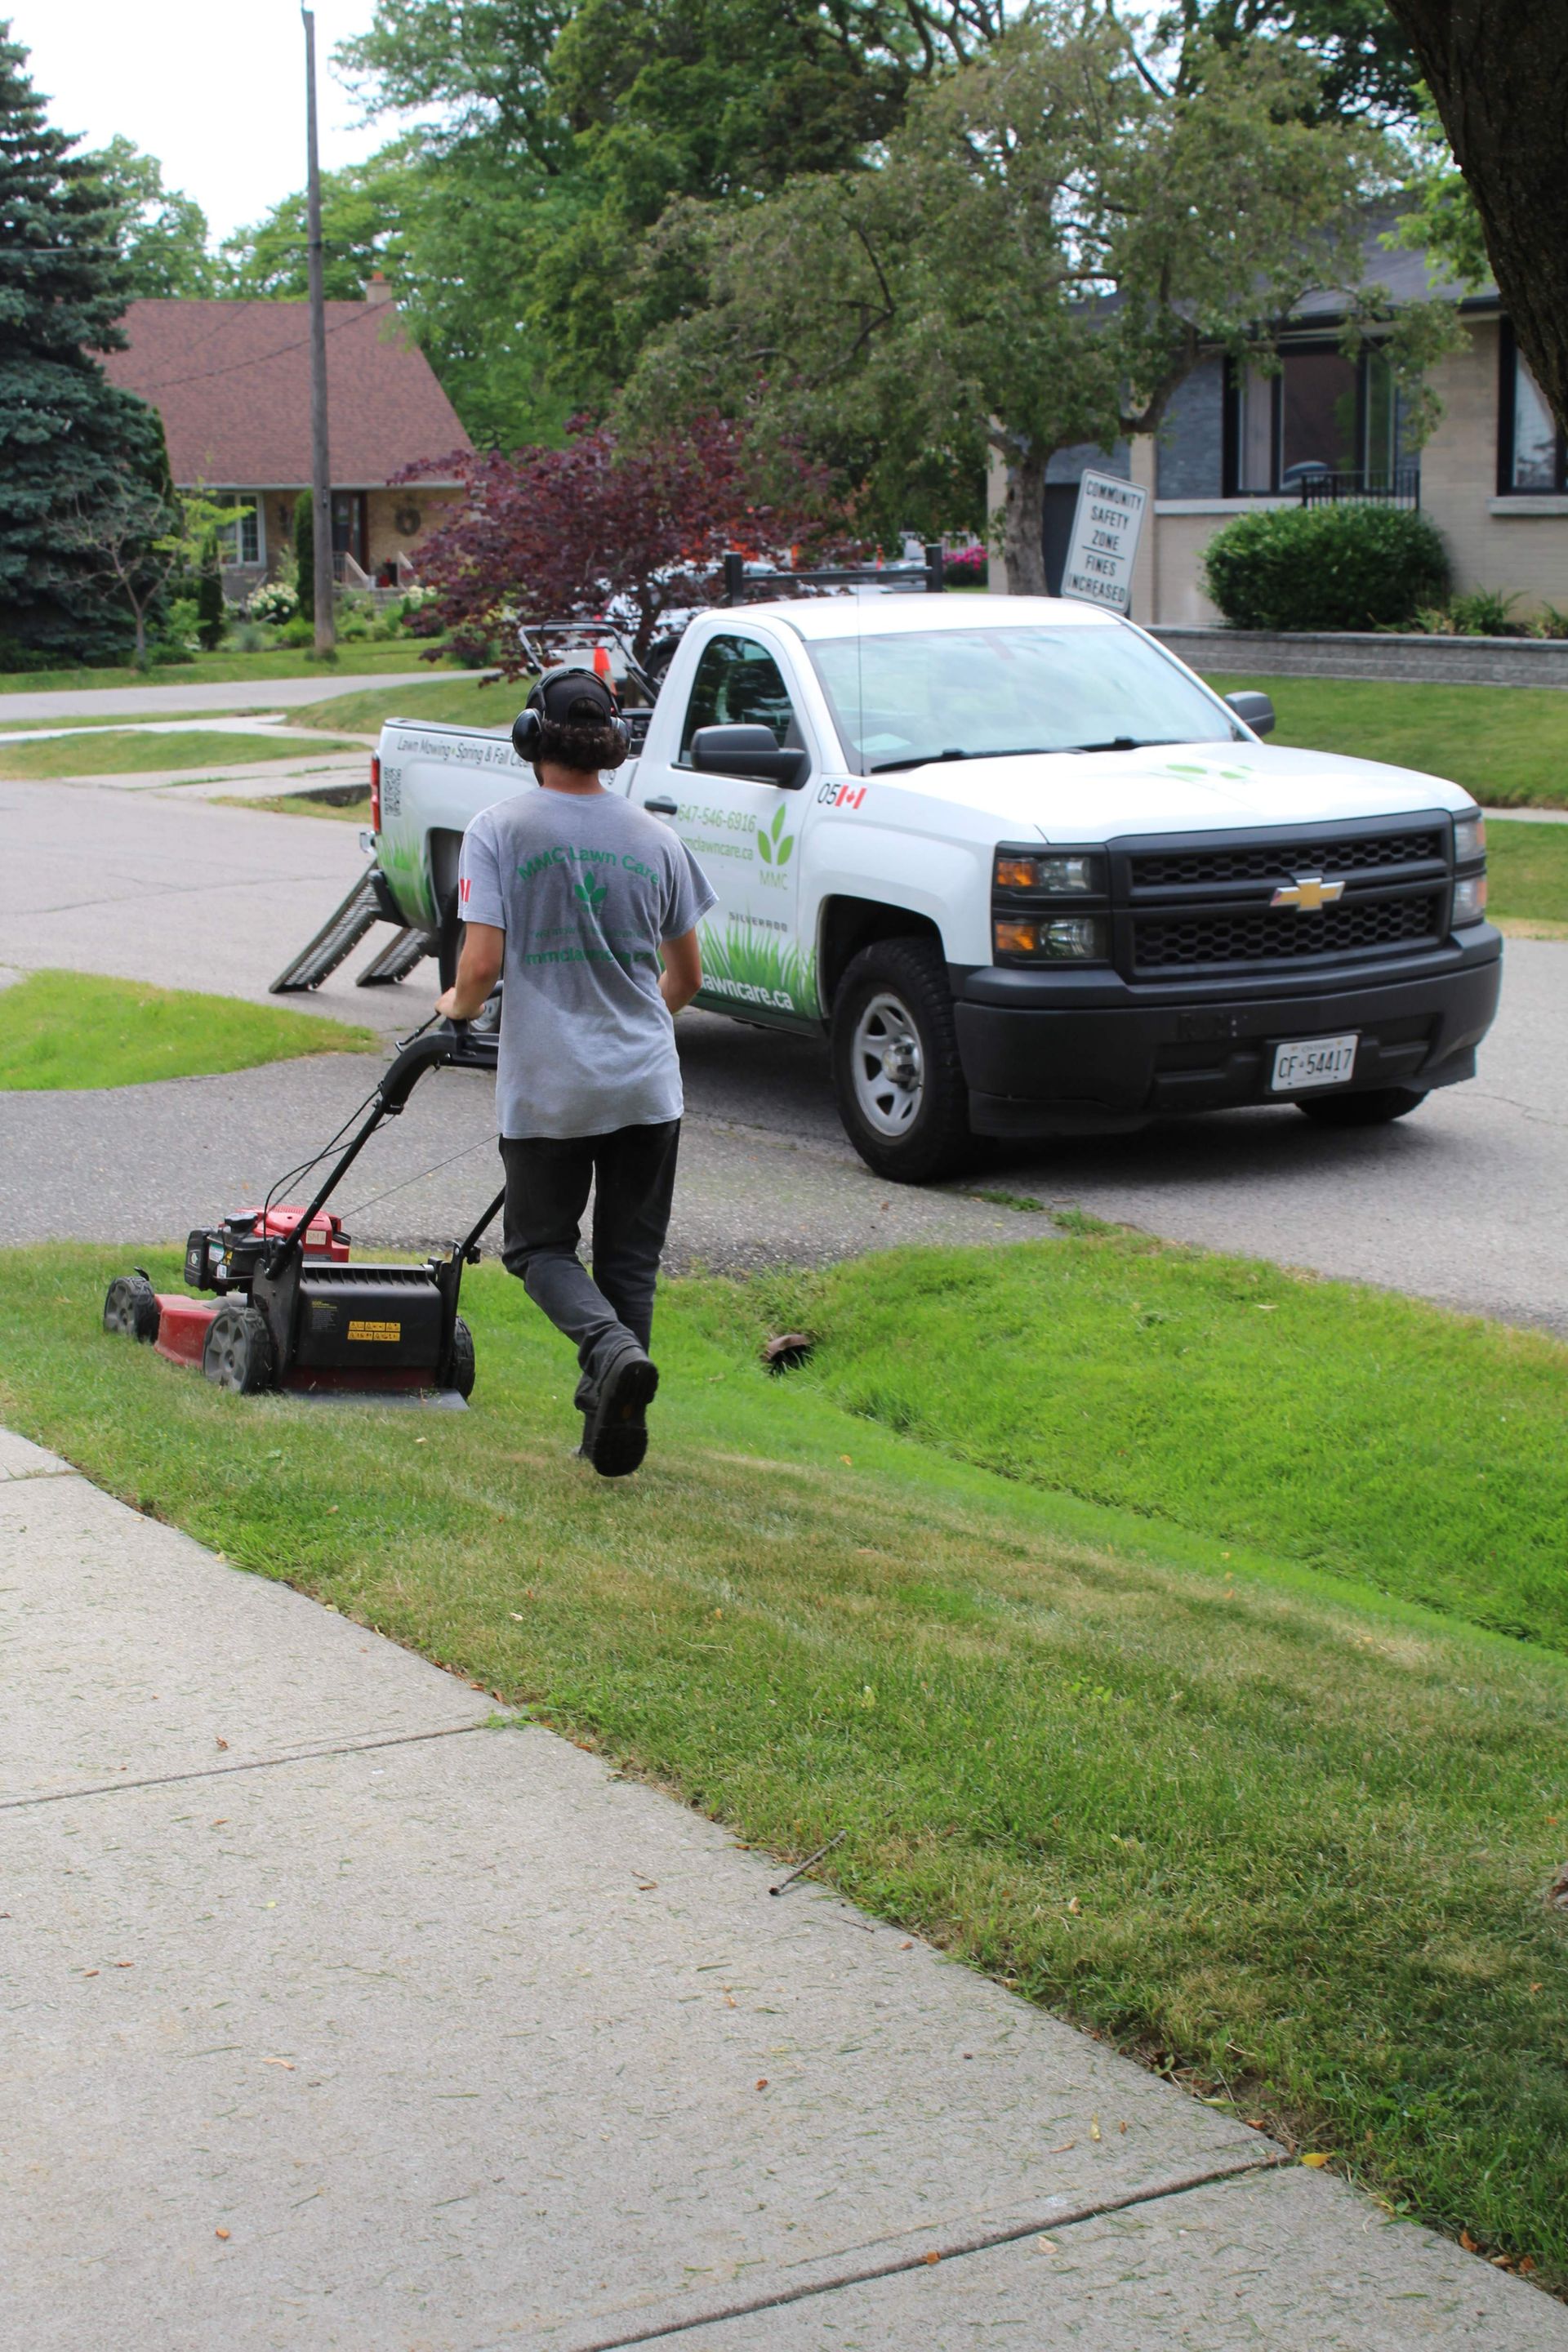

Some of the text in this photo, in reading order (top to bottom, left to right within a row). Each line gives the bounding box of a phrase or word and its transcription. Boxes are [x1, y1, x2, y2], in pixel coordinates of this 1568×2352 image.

[1085, 480, 1143, 510] COMMUNITY
[1090, 506, 1130, 530] SAFETY
[1091, 530, 1120, 551] ZONE
[1085, 555, 1116, 576] FINES
[1067, 573, 1126, 603] INCREASED
[397, 736, 532, 768] Lawn Mowing Spring & Fall Clea
[817, 783, 840, 804] 05
[517, 844, 659, 885] MMC Lawn Care
[759, 869, 788, 891] MMC
[728, 911, 789, 933] SILVERADO
